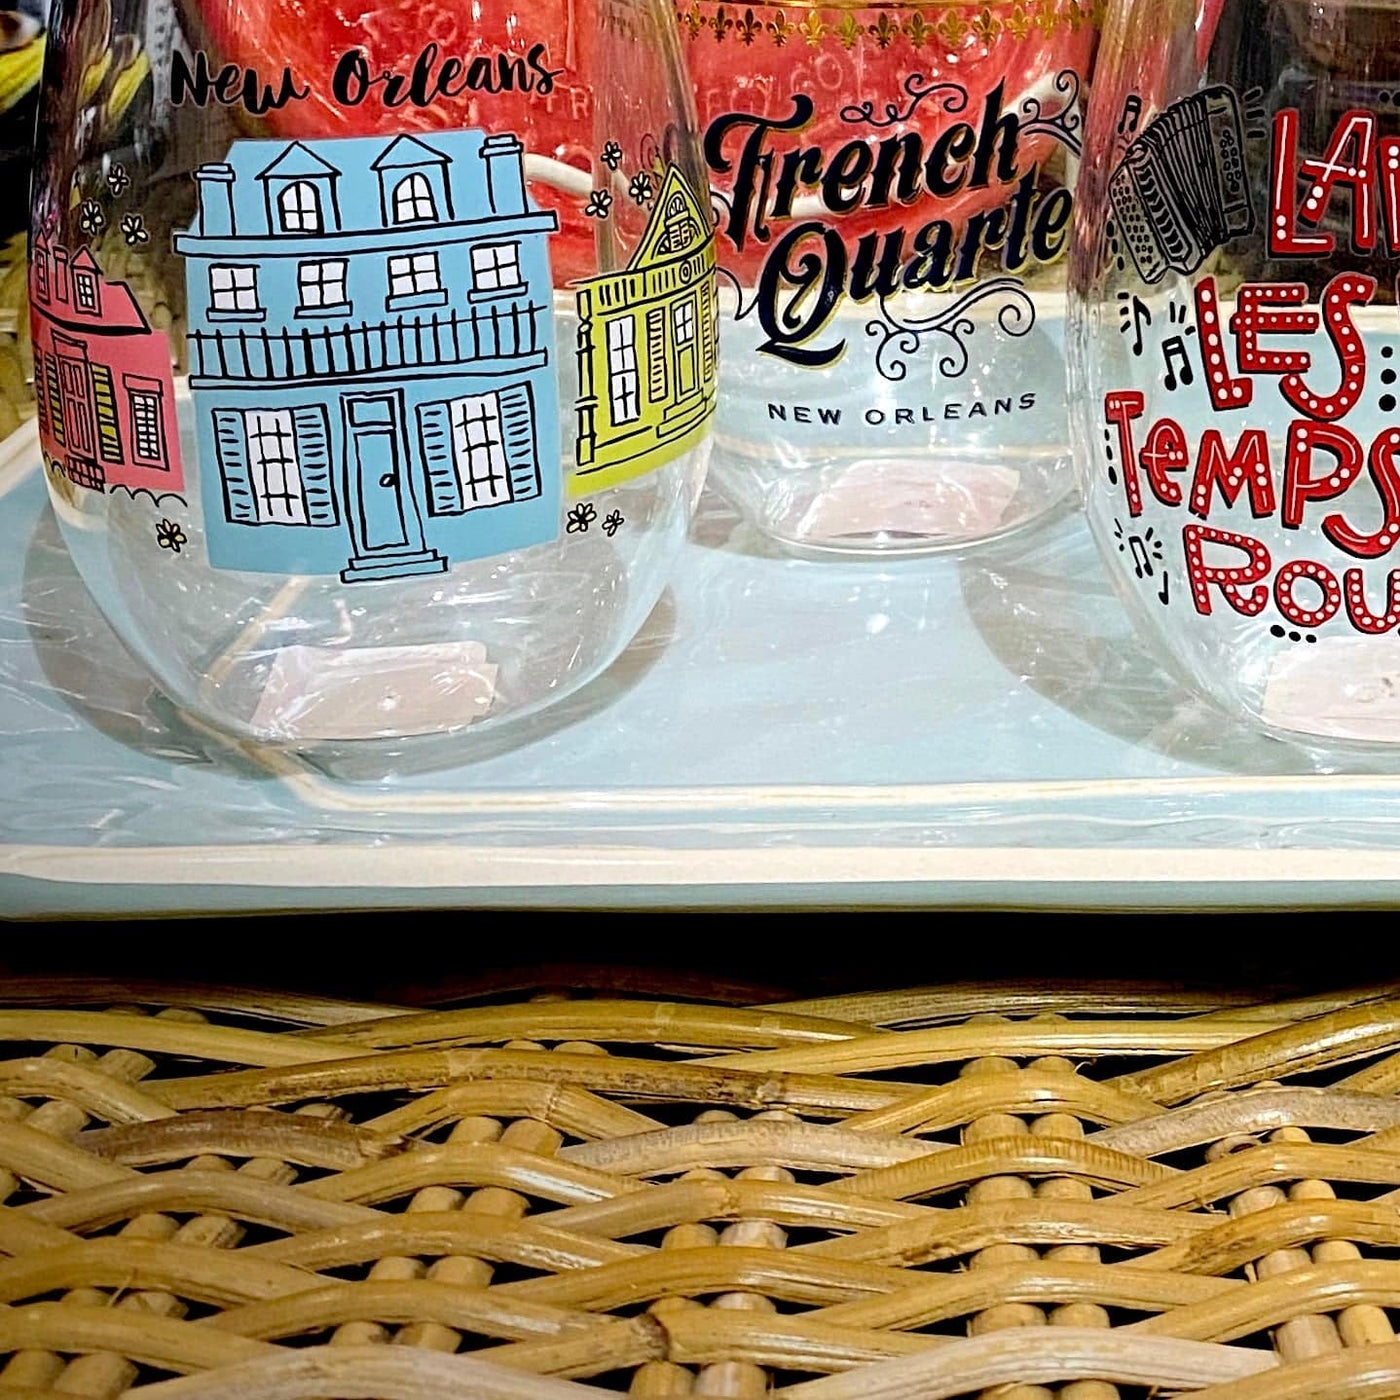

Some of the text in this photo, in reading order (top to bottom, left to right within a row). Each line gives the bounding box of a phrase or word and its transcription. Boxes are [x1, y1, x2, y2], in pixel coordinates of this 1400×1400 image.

[167, 42, 564, 115] New Orleans
[704, 76, 1022, 253] French
[755, 159, 1075, 369] Quarte
[767, 393, 1038, 426] NEW ORLEANS
[1193, 272, 1376, 422] LES
